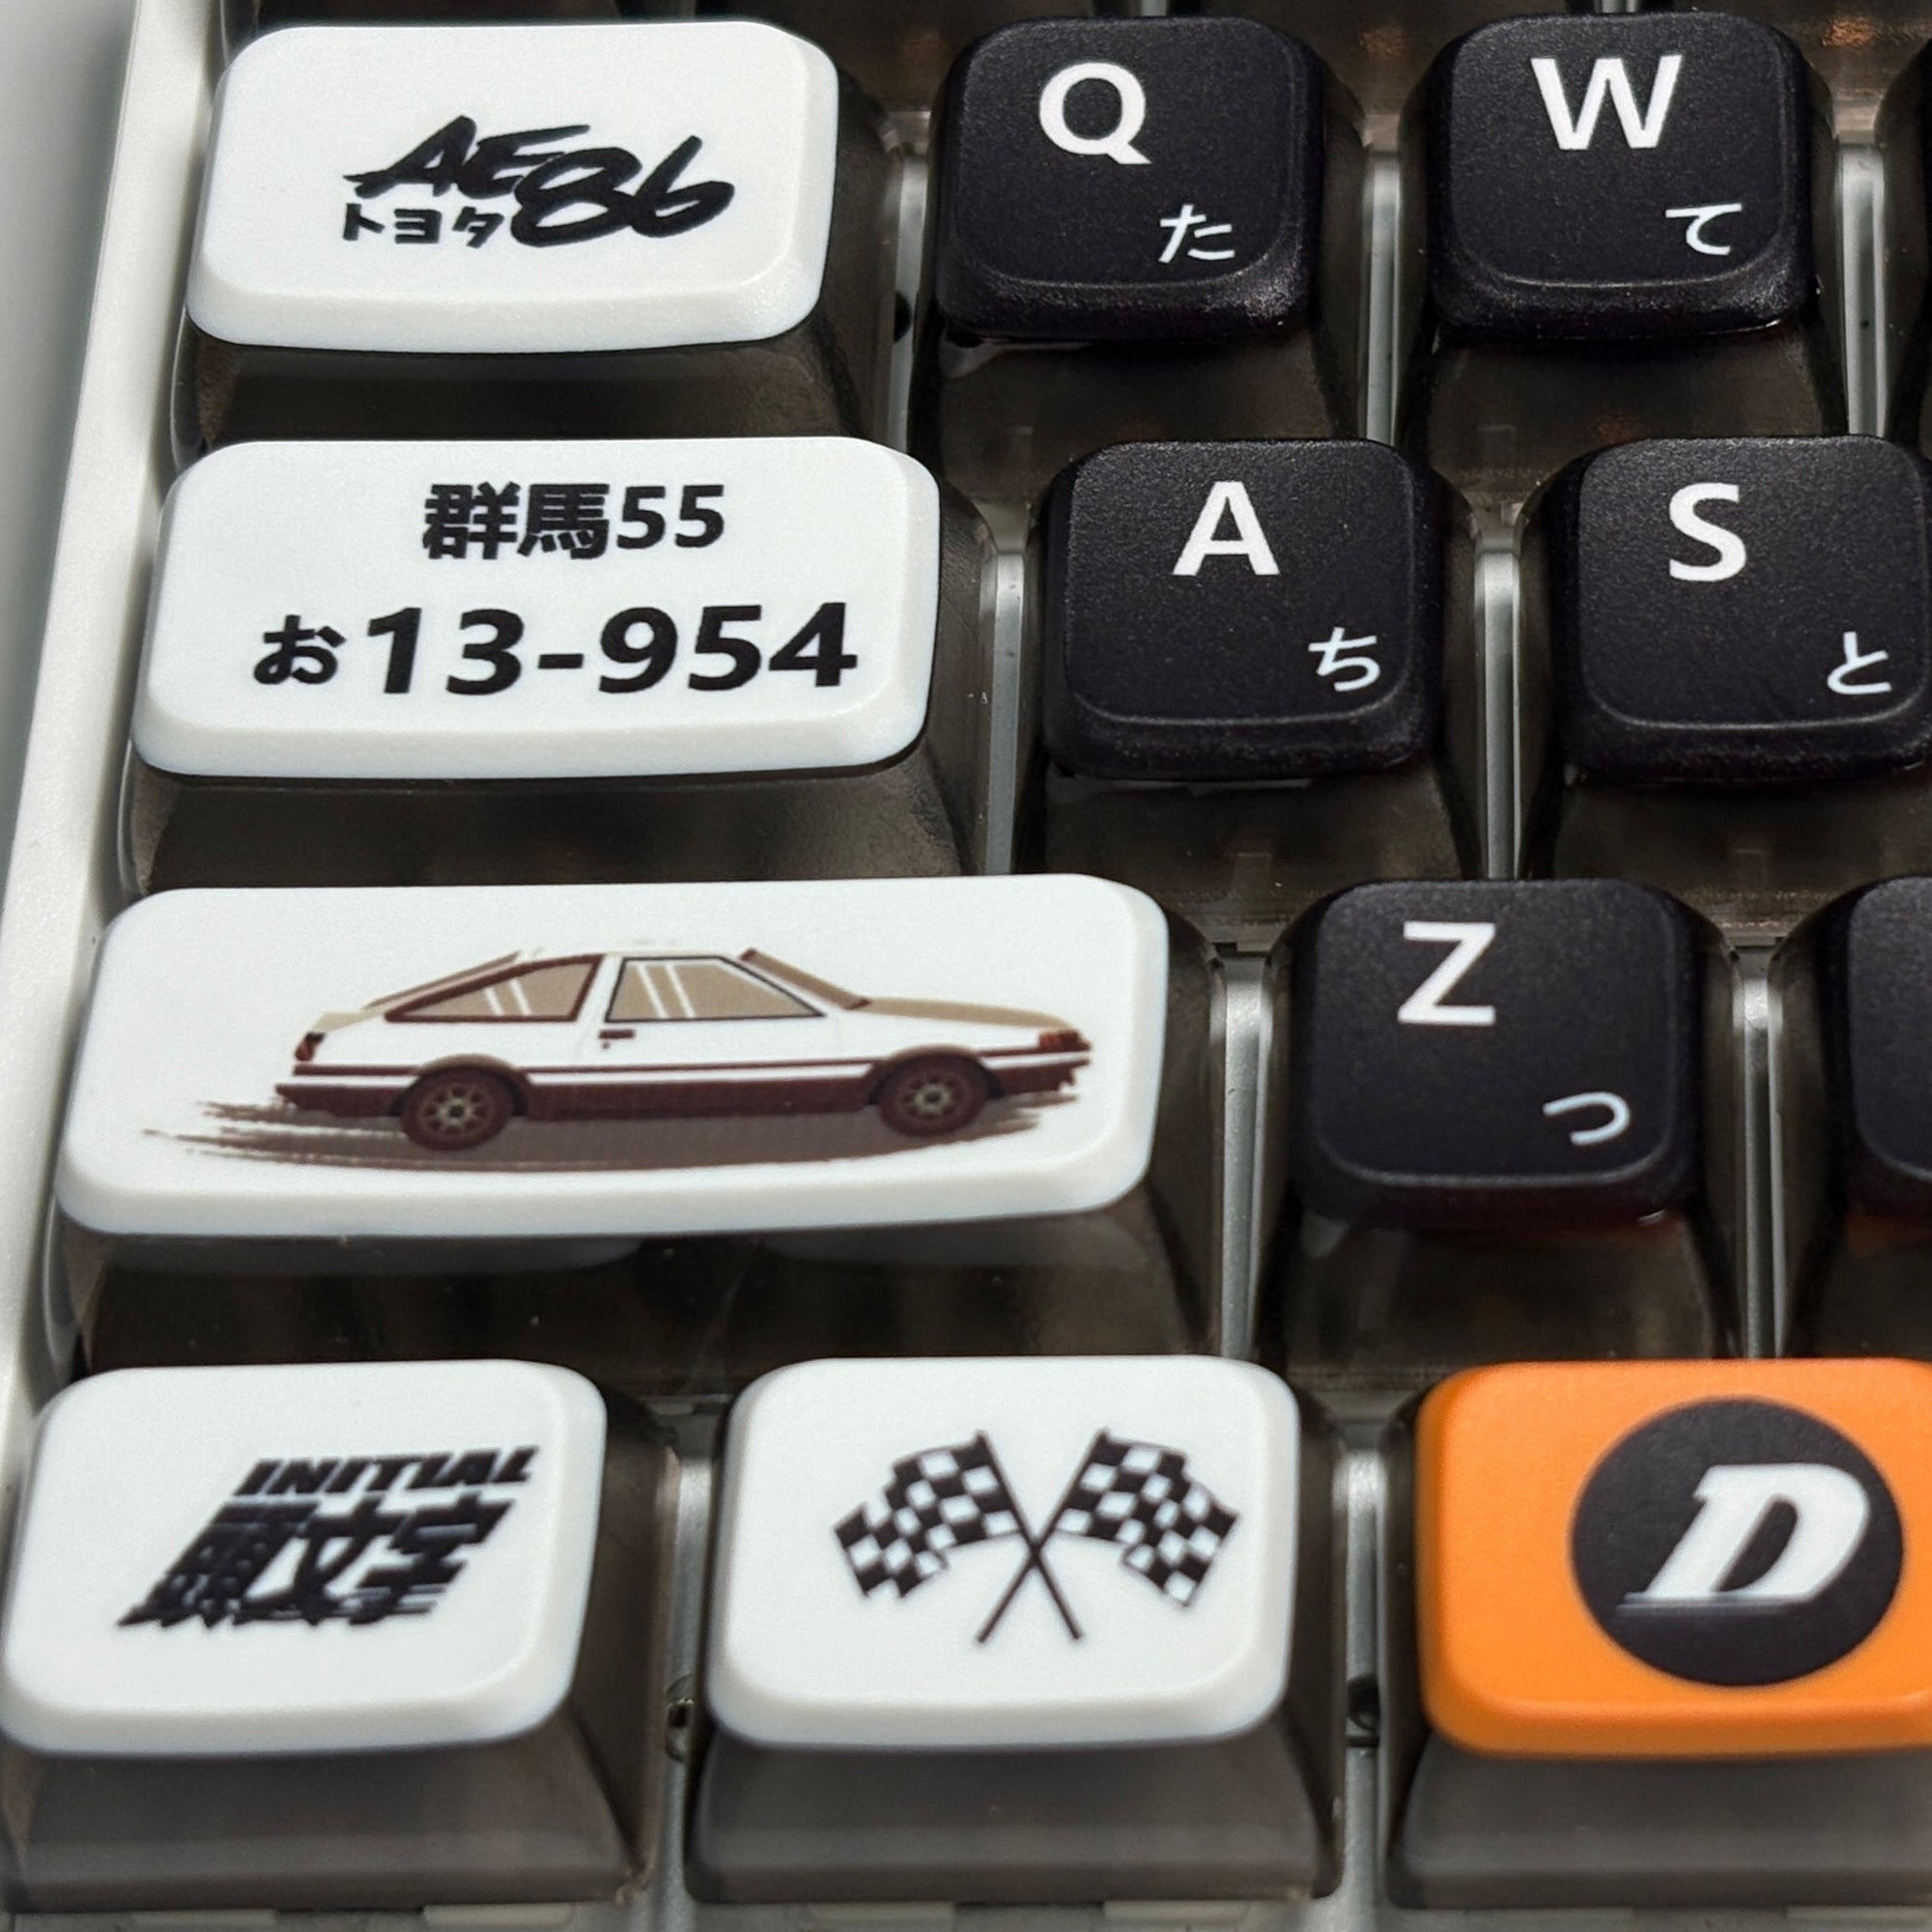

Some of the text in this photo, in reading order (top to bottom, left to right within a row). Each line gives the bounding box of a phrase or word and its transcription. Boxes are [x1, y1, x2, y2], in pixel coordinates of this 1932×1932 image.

[1038, 62, 1151, 165] Q
[1531, 54, 1683, 151] W
[343, 115, 735, 248] AE86
[343, 203, 503, 248] トヨタ
[1159, 204, 1236, 266] た
[1665, 203, 1743, 256] て
[422, 480, 724, 560] 群馬55
[1173, 480, 1281, 578] A
[1665, 482, 1749, 583] S
[1308, 627, 1380, 692] ち
[1827, 631, 1891, 696] と
[1398, 922, 1496, 1026] Z
[1544, 1093, 1630, 1145] つ
[233, 1447, 539, 1496] INITIAL
[1621, 1462, 1870, 1604] D
